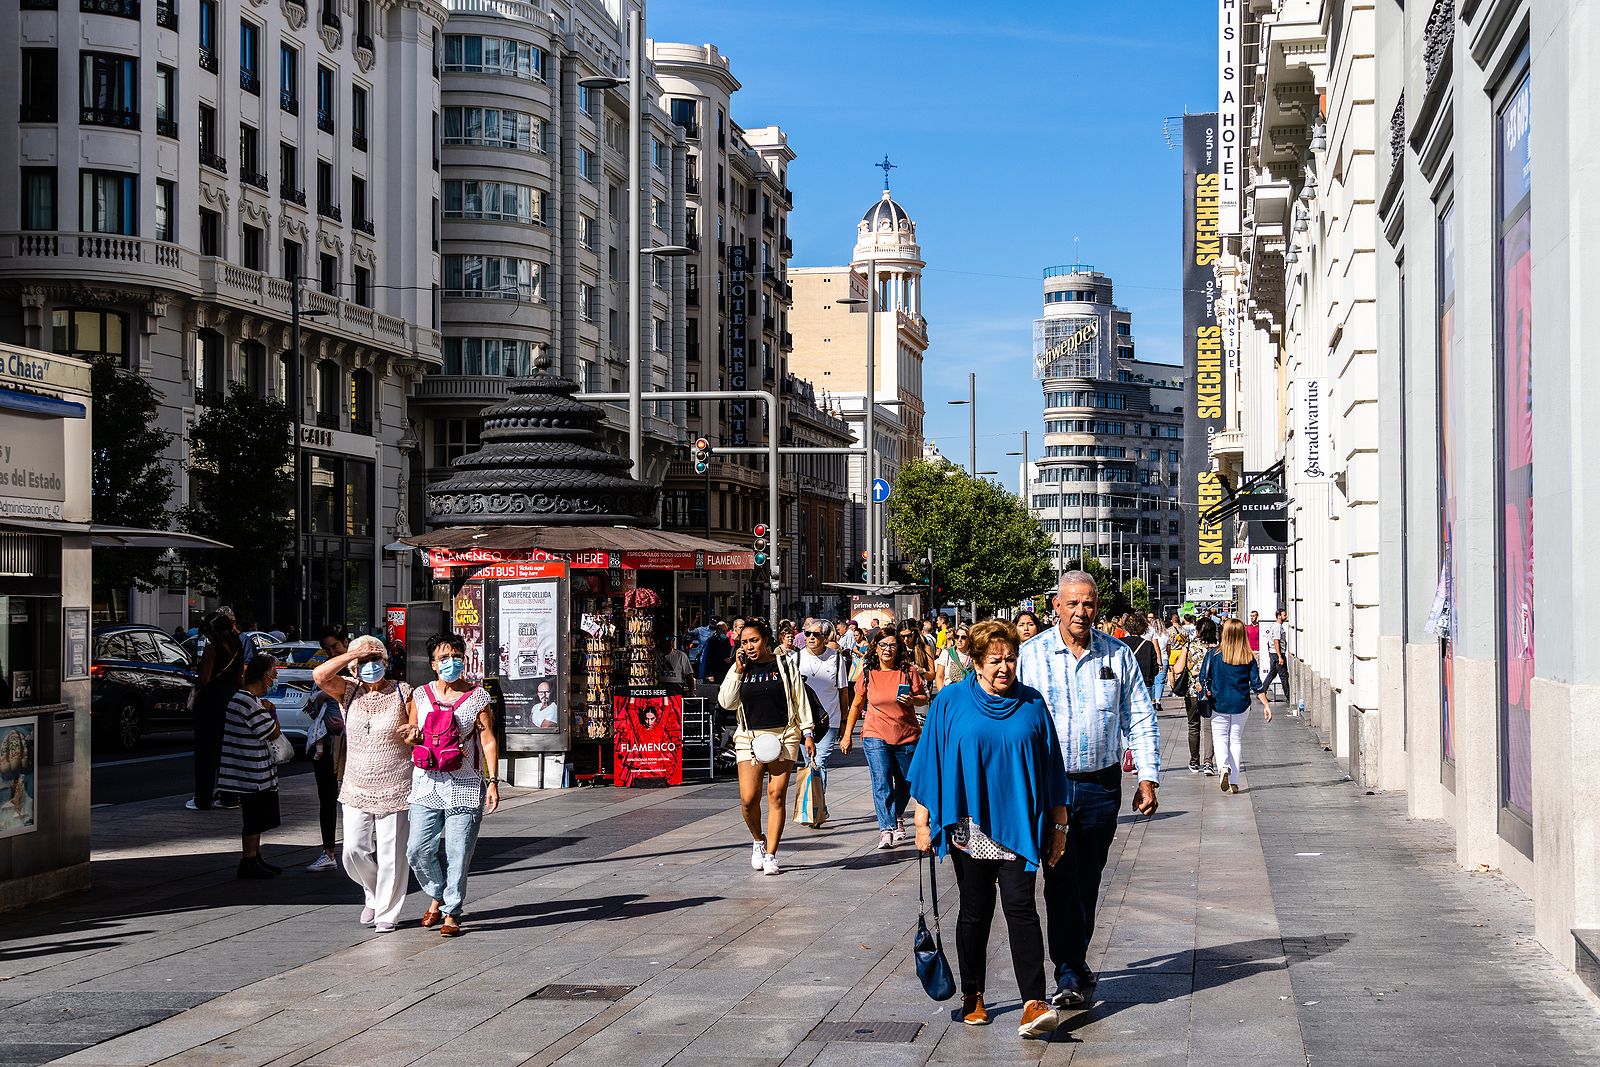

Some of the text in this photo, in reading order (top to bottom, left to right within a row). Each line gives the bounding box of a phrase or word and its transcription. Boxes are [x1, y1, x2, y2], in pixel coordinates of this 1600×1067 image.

[1223, 50, 1235, 80] IS
[1222, 90, 1235, 104] A
[1222, 113, 1235, 191] HOTEL
[1196, 172, 1219, 266] SKECHERS
[1206, 280, 1214, 301] UNO
[1035, 319, 1098, 370] Schweppes
[732, 270, 745, 445] HOTEL REGNTE
[1197, 325, 1221, 419] SKECHERS
[1304, 380, 1319, 469] stradivarius
[11, 468, 26, 487] del
[28, 471, 61, 490] Estado
[53, 505, 60, 516] 42
[435, 551, 502, 562] FLAMENCO
[576, 553, 604, 564] HERE
[707, 555, 741, 565] FLAMENCO
[496, 566, 515, 577] BUS
[458, 599, 474, 609] CASA
[455, 609, 479, 624] CACTUS
[16, 686, 32, 698] 174
[621, 742, 676, 752] FLAMENCO
